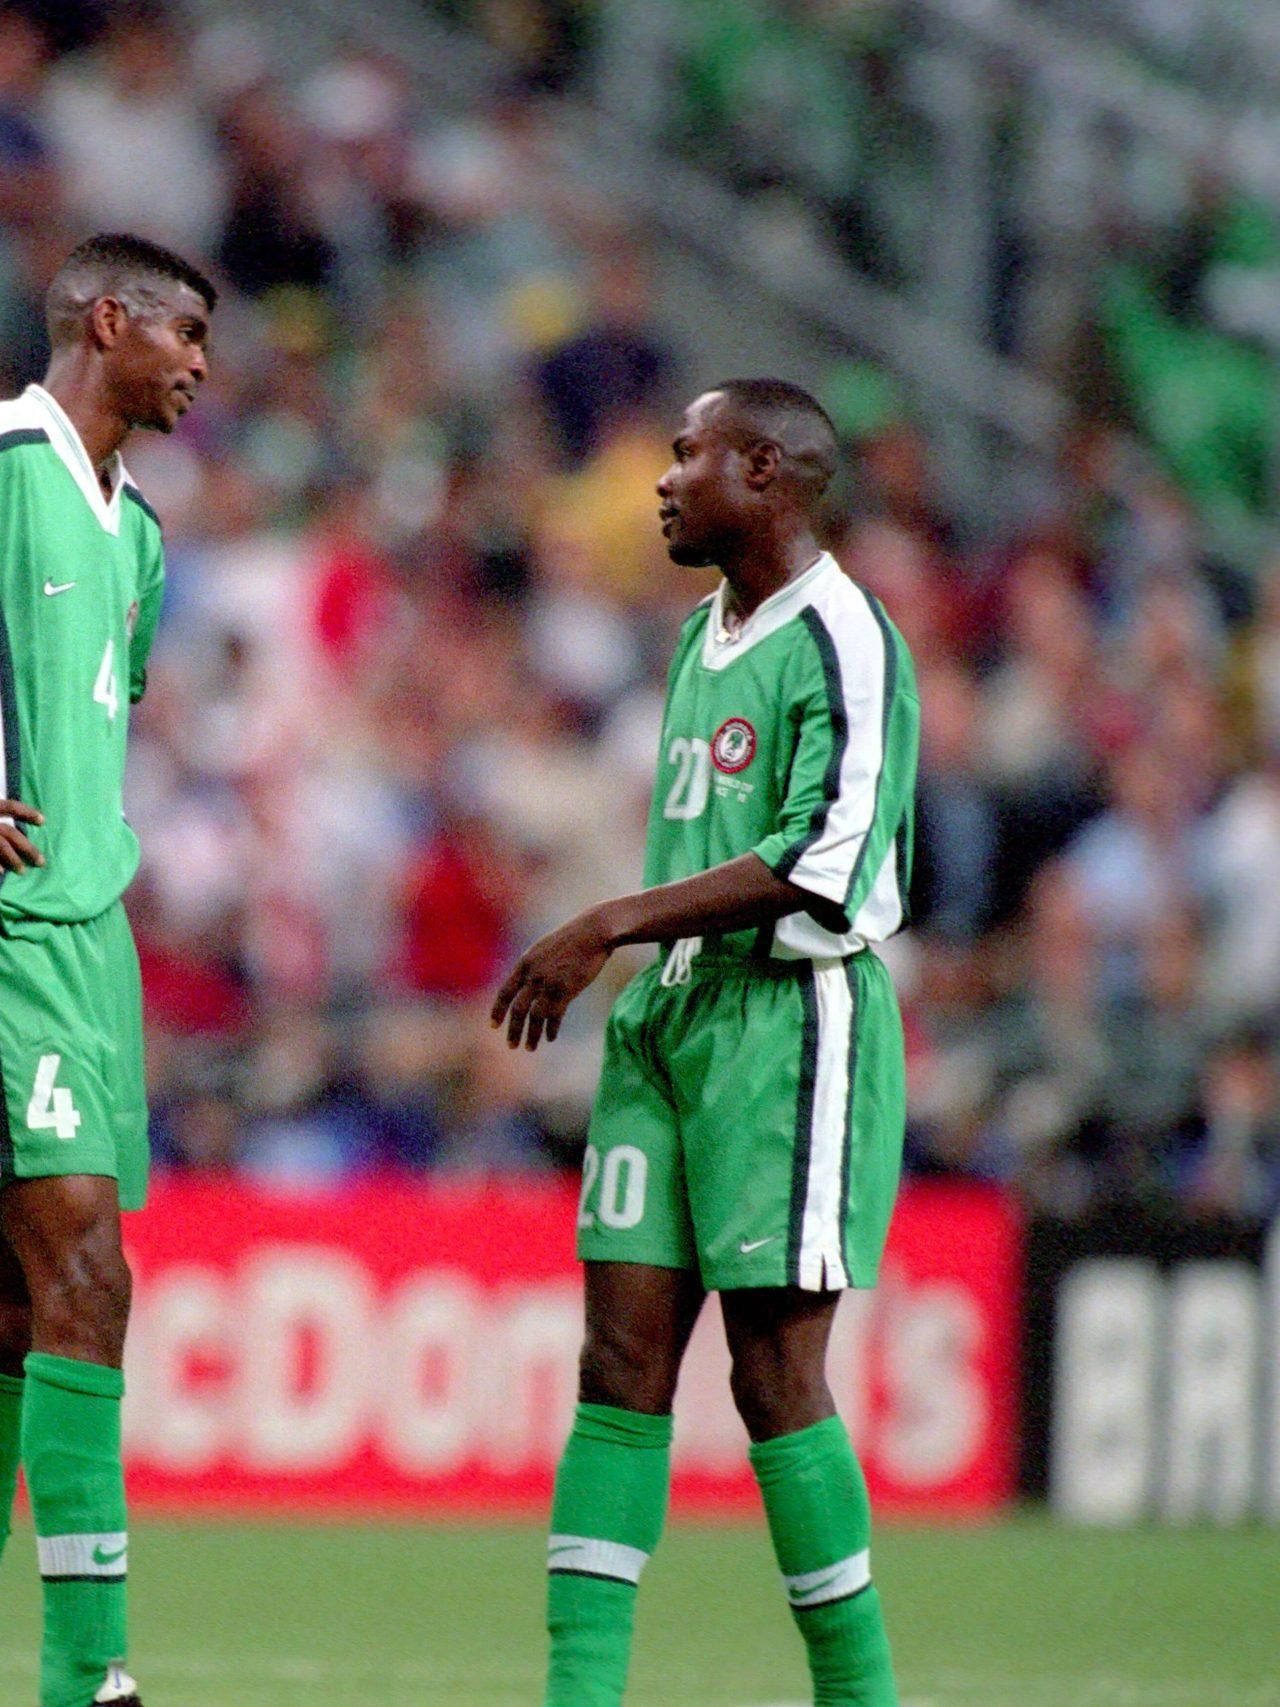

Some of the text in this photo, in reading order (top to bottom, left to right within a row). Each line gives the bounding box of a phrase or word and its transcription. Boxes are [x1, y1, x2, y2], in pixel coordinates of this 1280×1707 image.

[93, 639, 118, 718] 4
[27, 1054, 81, 1138] 4
[578, 1144, 647, 1229] 20
